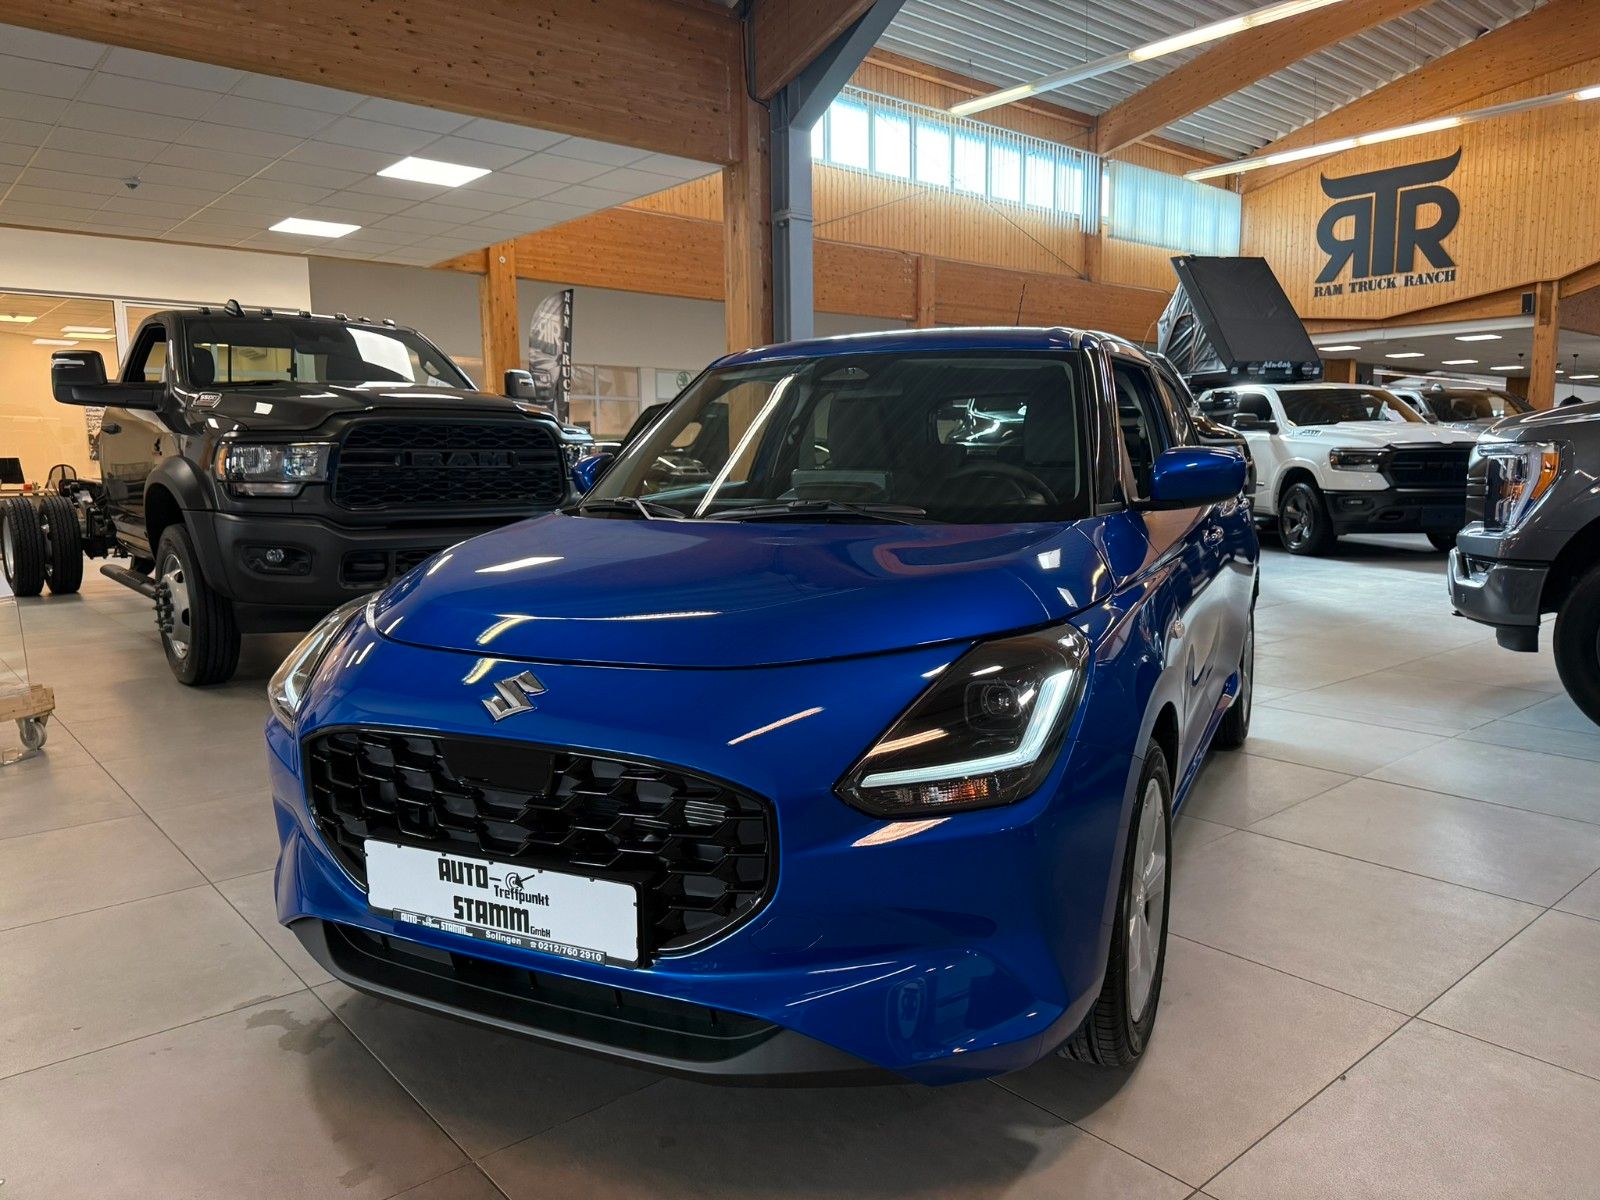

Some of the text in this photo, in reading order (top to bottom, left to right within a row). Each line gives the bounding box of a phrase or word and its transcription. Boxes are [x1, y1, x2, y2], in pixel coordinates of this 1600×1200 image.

[1313, 269, 1456, 298] RAM TRUCK RANCH
[411, 449, 507, 468] RAM
[493, 884, 550, 907] Treffpunkt
[453, 895, 551, 939] STAMM GmbH
[441, 921, 467, 936] STAMM
[485, 930, 522, 945] Solingen
[538, 941, 578, 957] 0212/760
[579, 949, 603, 962] 2910
